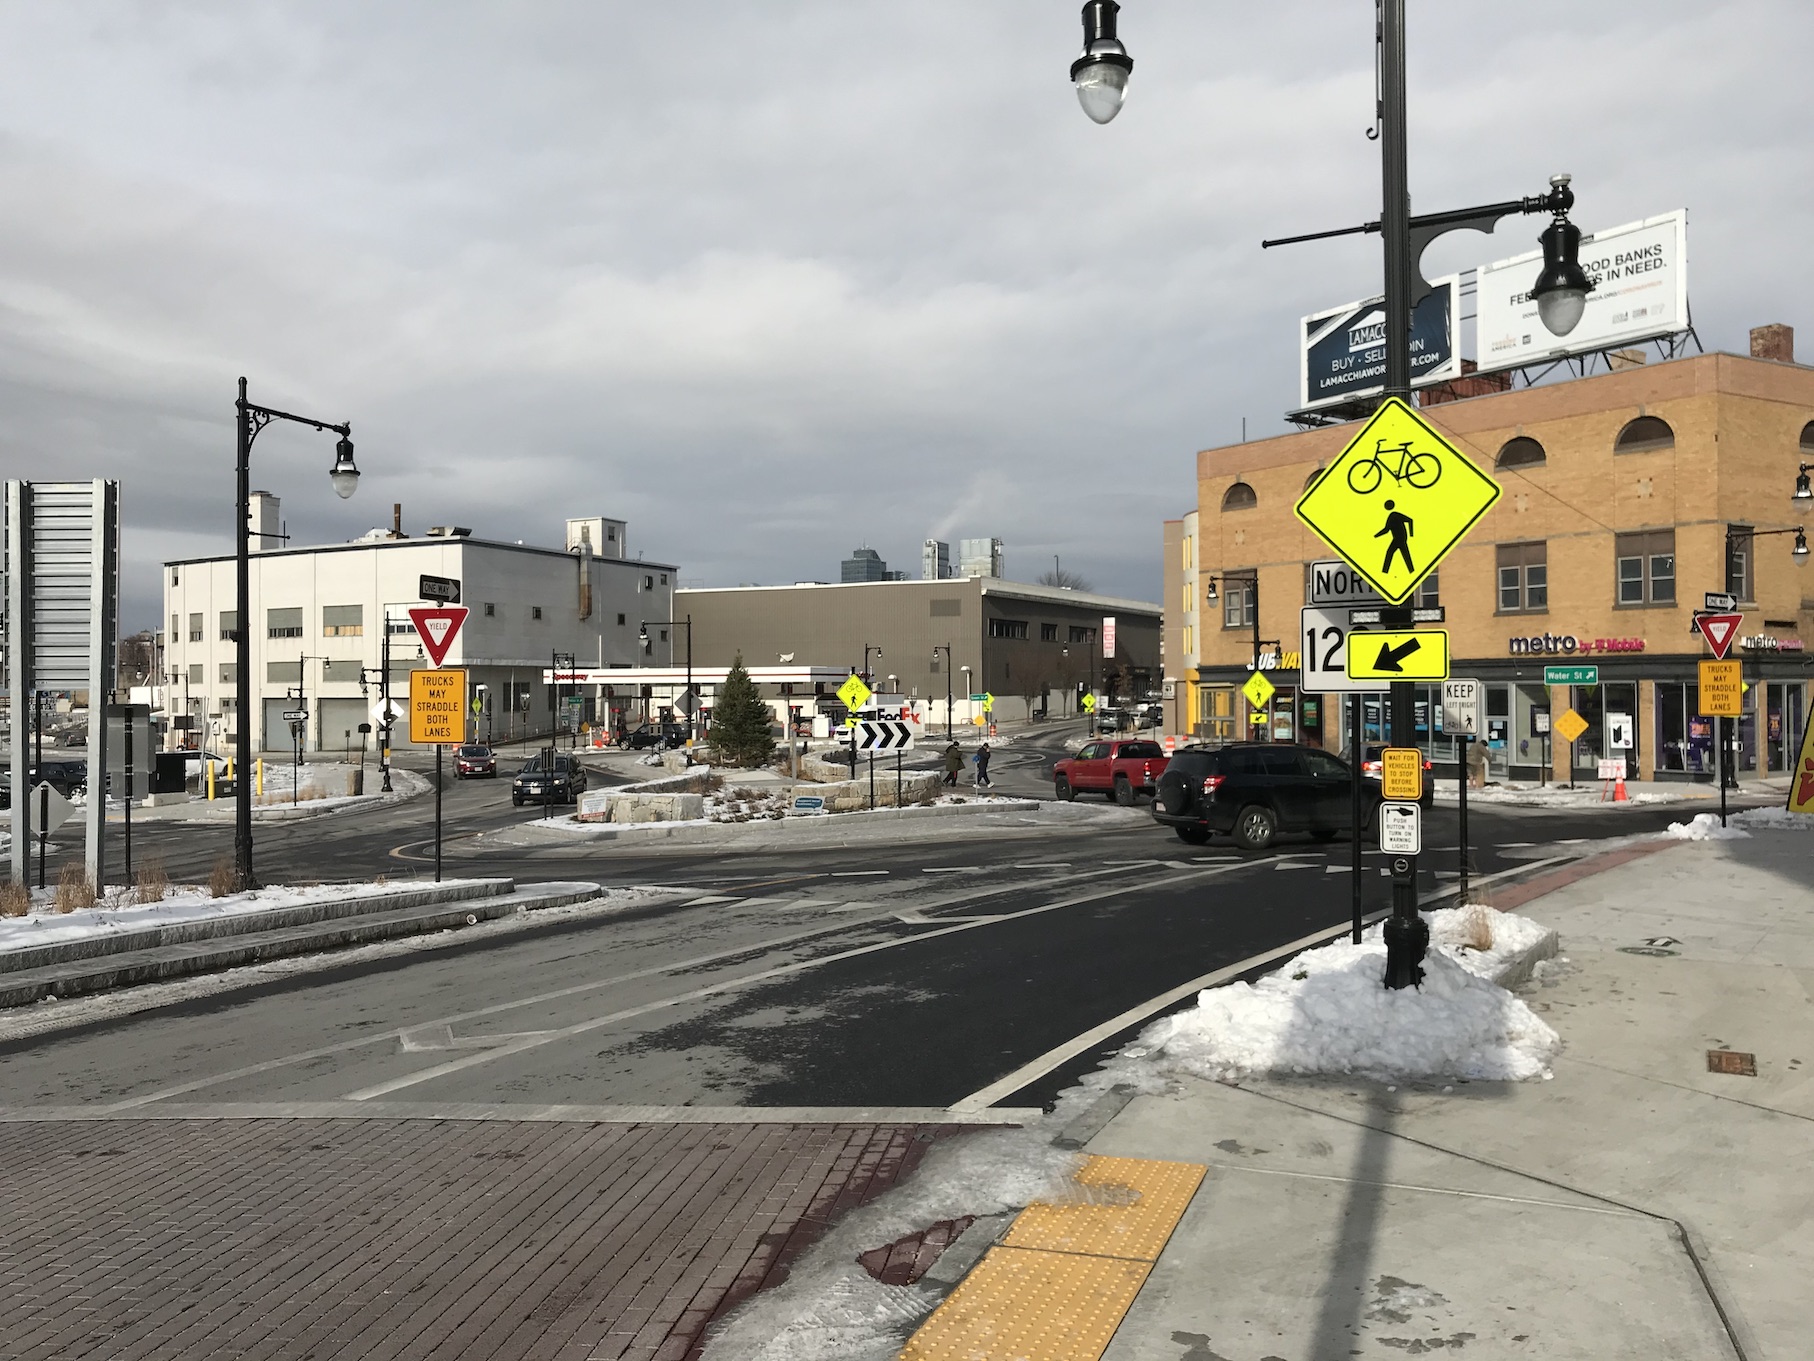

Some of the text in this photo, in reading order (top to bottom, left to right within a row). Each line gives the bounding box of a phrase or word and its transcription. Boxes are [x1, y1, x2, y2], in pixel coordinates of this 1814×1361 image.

[1581, 243, 1662, 274] OOD BANKS
[1607, 268, 1620, 281] IN
[1625, 257, 1667, 276] NEED.
[1349, 323, 1387, 346] LAMACC
[1331, 355, 1355, 372] BUY
[1316, 569, 1372, 595] NOR
[425, 583, 449, 595] ONE WAY
[1708, 596, 1728, 606] ONE WAY
[429, 622, 447, 630] YIELD
[1712, 625, 1727, 633] YIELD
[1509, 632, 1577, 654] metro
[1579, 639, 1592, 656] by
[1745, 634, 1778, 649] metro
[1307, 626, 1369, 672] 12
[1707, 665, 1733, 673] TRUCKS
[1547, 671, 1583, 680] Water St
[1713, 675, 1727, 683] MAY
[422, 676, 454, 686] TRUCKS
[1446, 684, 1474, 698] KEEP
[1704, 684, 1736, 692] STRADDLE
[429, 689, 446, 699] MAY
[1712, 694, 1729, 702] BOTH
[416, 702, 458, 712] STRADDLE
[1446, 701, 1476, 709] LEFT RIGHT
[1710, 703, 1731, 711] LANES
[427, 715, 448, 724] BOTH
[424, 727, 451, 737] LANES
